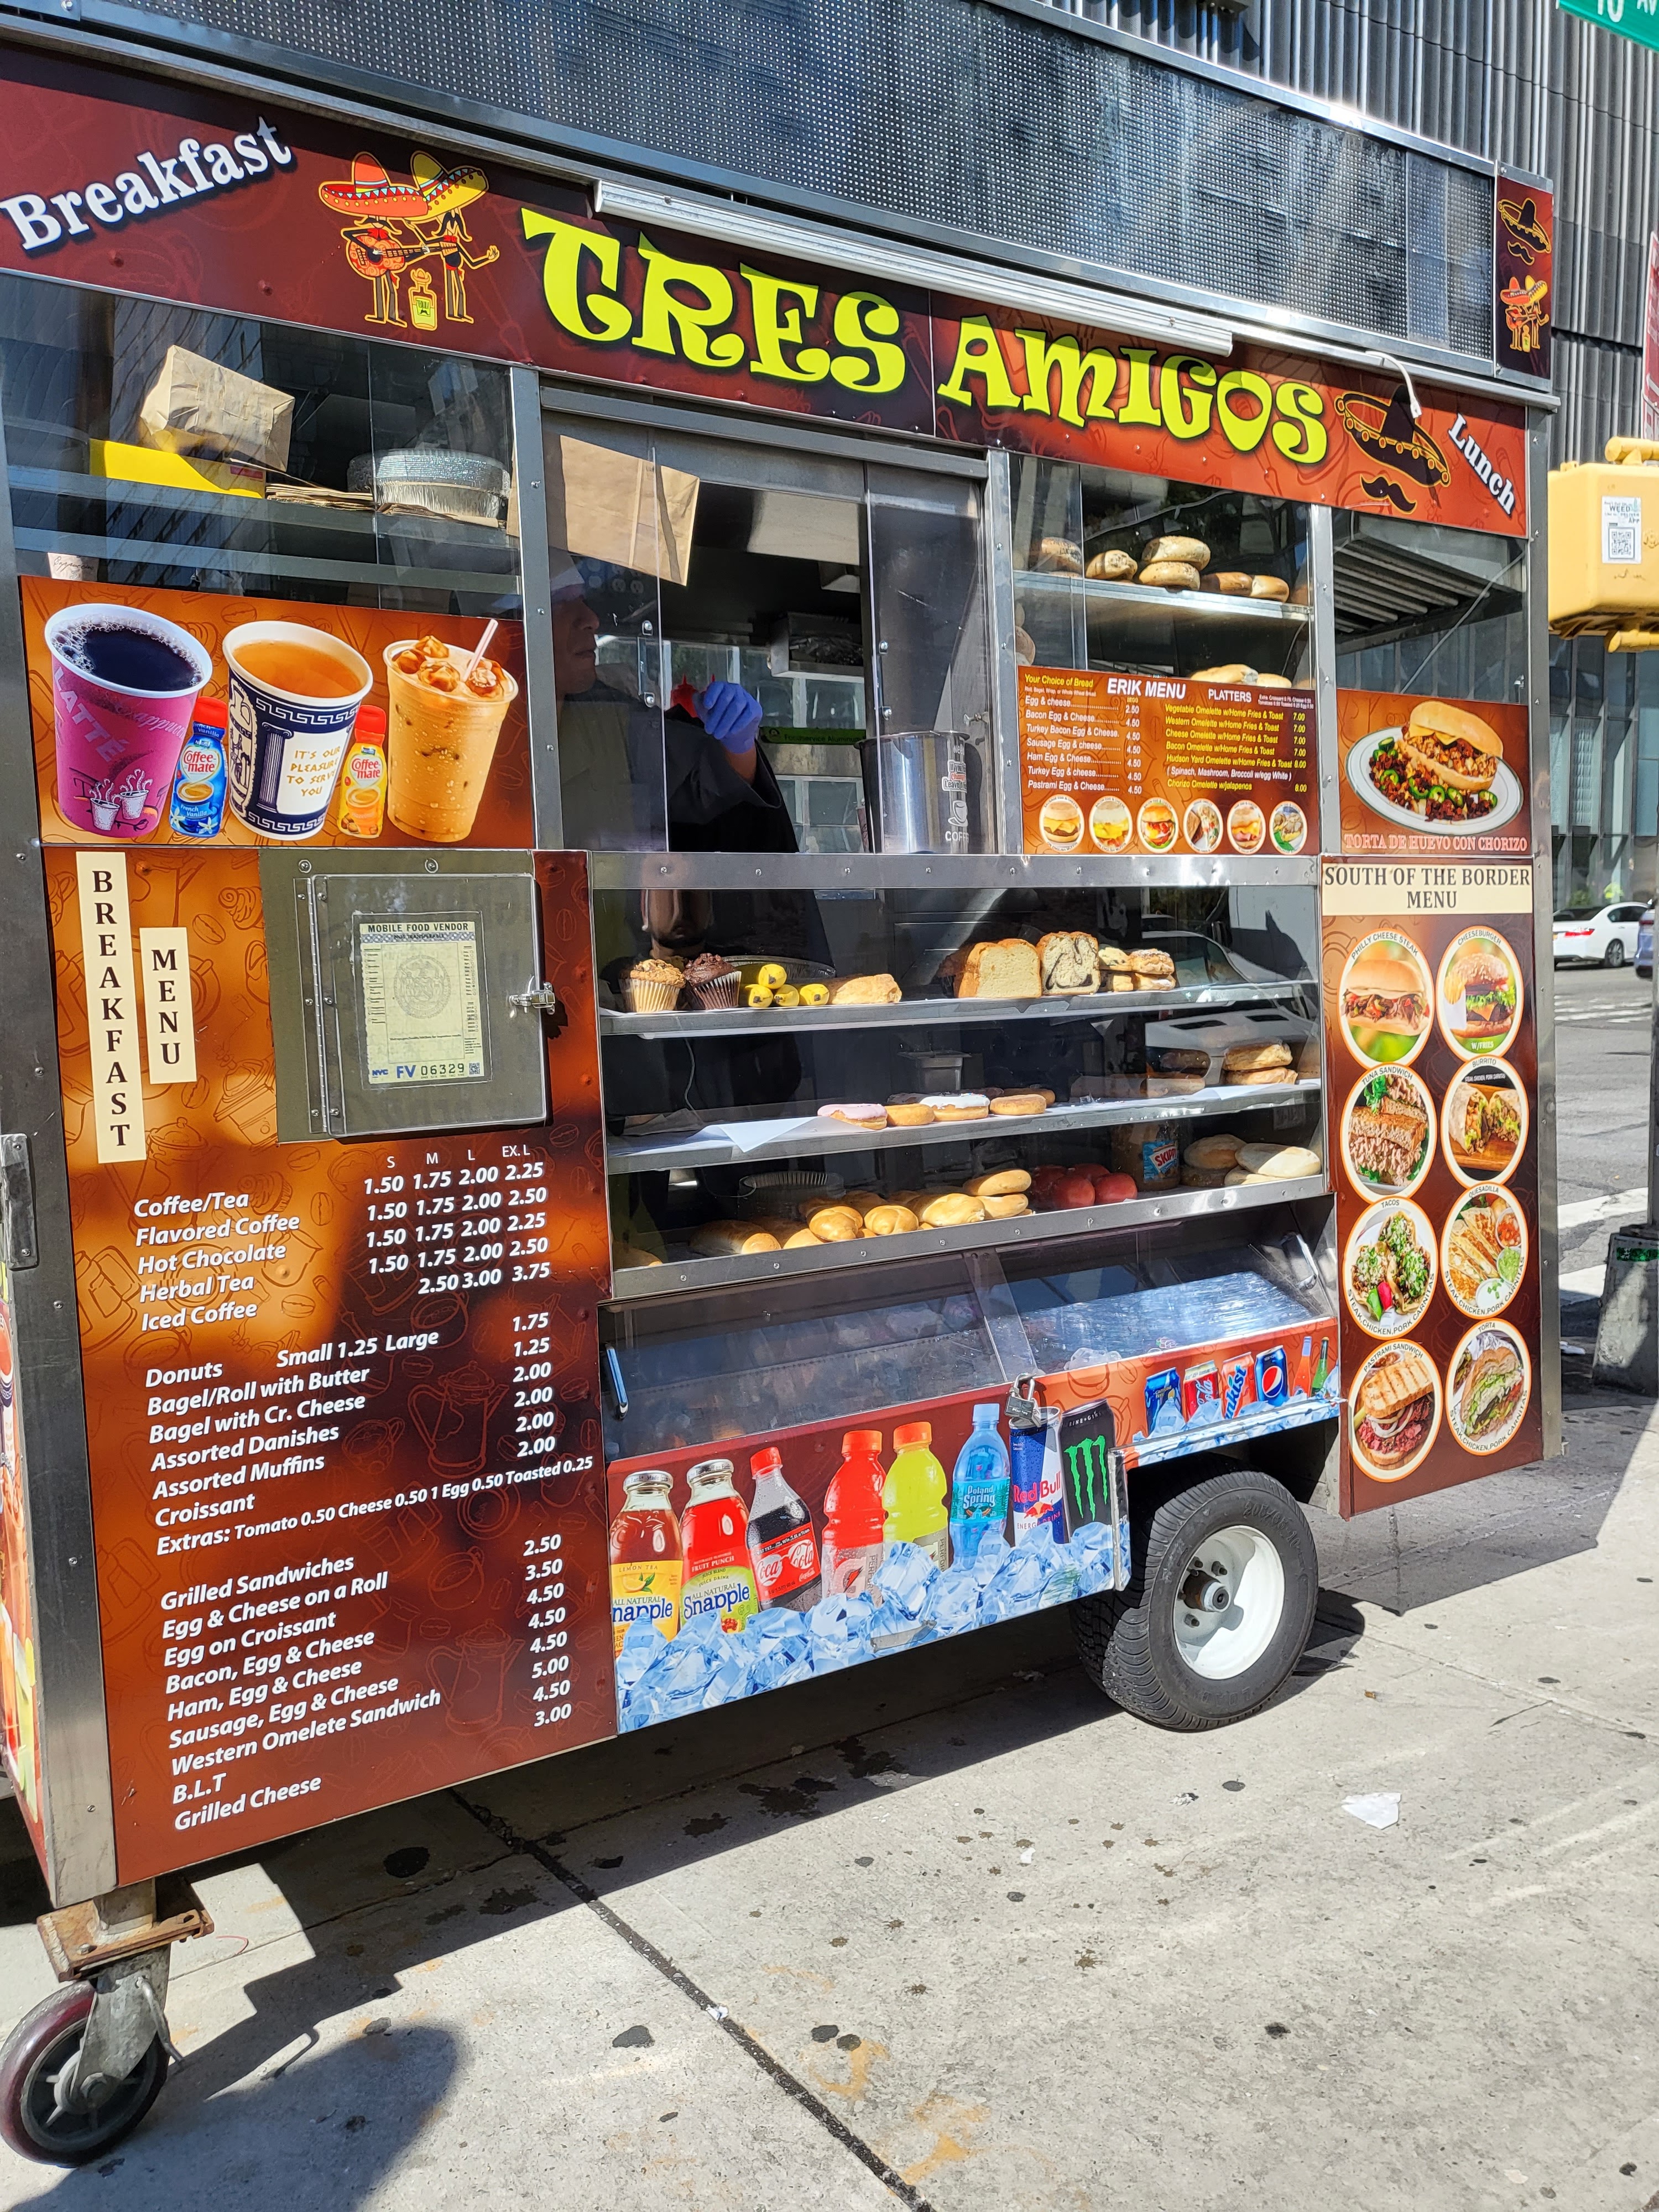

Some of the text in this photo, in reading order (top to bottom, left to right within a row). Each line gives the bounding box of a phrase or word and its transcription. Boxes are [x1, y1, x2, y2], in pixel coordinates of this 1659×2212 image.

[2, 116, 293, 251] Breakfast
[521, 208, 1328, 465] TRES AMIGOS
[1448, 413, 1516, 515] Lunch
[1025, 674, 1093, 688] Your Choice of Bread
[1107, 677, 1142, 696] ERIK
[1145, 680, 1186, 699] MENU
[1025, 695, 1039, 707] Egg
[1041, 697, 1046, 705] &
[1208, 688, 1252, 703] PLATTERS
[54, 666, 129, 762] LATTÉ
[1026, 724, 1048, 735] Turkey
[1051, 725, 1071, 735] Bacon
[1072, 726, 1086, 737] Egg
[1087, 727, 1092, 736] &
[294, 746, 340, 759] IT'S OUR
[1166, 754, 1189, 763] Hudson
[1191, 755, 1204, 764] Yard
[1233, 758, 1255, 766] w/Home
[1256, 759, 1270, 768] Fries
[1277, 760, 1292, 769] Toast
[187, 763, 215, 773] mate
[290, 758, 339, 773] PLEASURE
[357, 769, 381, 779] mate
[286, 770, 335, 785] TO SERVE
[1167, 779, 1190, 788] Chorizo
[301, 786, 322, 797] YOU
[180, 804, 199, 812] French
[186, 809, 207, 817] Vanilla
[1344, 833, 1527, 852] TORTA DE HUEVO CON CHORIZO
[1325, 867, 1530, 885] SOUTH OF THE BORDER
[1407, 890, 1458, 909] MENU
[368, 923, 468, 933] MOBILE FOOD VENDOR
[1457, 930, 1501, 946] CHEESEBURGER
[1351, 931, 1418, 959] PHILLY CHEESE STEAK
[91, 869, 131, 1148] BREAKFAST
[151, 949, 182, 1066] MENU
[1471, 1040, 1494, 1051] W/FRIES
[396, 1065, 416, 1079] FV
[420, 1063, 465, 1076] 06329
[1472, 1058, 1496, 1067] BURRITO
[1361, 1066, 1413, 1086] TUNA SANDWICH
[387, 1144, 531, 1168] S M L EX. L
[1155, 1148, 1177, 1167] SKIPP
[364, 1162, 544, 1194] 1.50 1.75 2.00 2.25
[1469, 1185, 1499, 1199] QUESADILLA
[134, 1192, 249, 1217] Coffee/Tea
[1381, 1199, 1400, 1208] TACOS
[135, 1213, 300, 1246] Flavored Coffee
[138, 1244, 286, 1275] Hot Chocolate
[418, 1261, 550, 1295] 2.50 3.00 3.75
[142, 1301, 257, 1331] Iced Coffee
[513, 1312, 549, 1332] 1.75
[1478, 1322, 1496, 1332] TORTA
[145, 1332, 439, 1387] Donuts Small 1.25 Large
[1364, 1343, 1424, 1373] PASTRAMI SANDWICH
[147, 1368, 370, 1416] Bagel/Roll with Butter
[967, 1484, 994, 1495] Poland
[1012, 1470, 1061, 1503] Red Bull
[155, 1493, 255, 1527] Croissant
[963, 1494, 995, 1509] Spring
[523, 1534, 561, 1557] 2.50
[692, 1556, 734, 1572] FRUIT PUNCH
[160, 1557, 354, 1610] Grilled Sandwiches
[691, 1583, 737, 1600] ALL NATURAL
[162, 1571, 388, 1640] Egg & Cheese on a Roll
[613, 1598, 672, 1623] napple
[684, 1583, 750, 1619] Snapple
[534, 1703, 572, 1727] 3.00
[172, 1689, 441, 1776] Western Omelete Sandwich
[173, 1772, 227, 1804] B.L.T
[175, 1777, 321, 1830] Grilled Cheese
